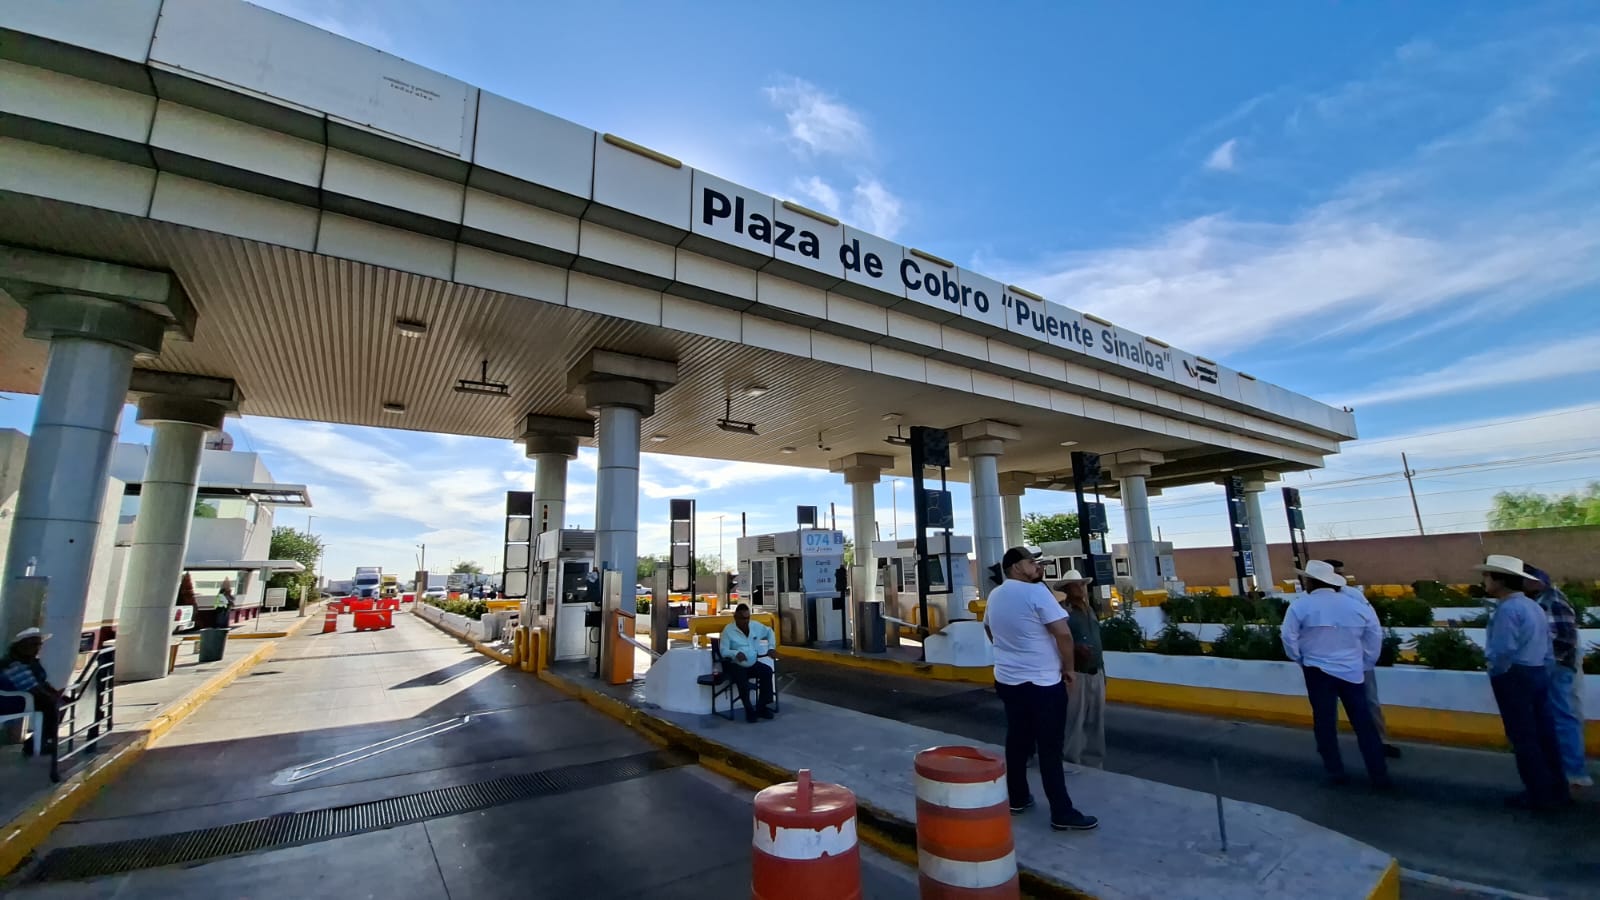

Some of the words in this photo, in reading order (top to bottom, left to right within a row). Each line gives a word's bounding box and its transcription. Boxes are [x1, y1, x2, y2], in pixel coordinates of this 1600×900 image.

[703, 187, 820, 260] Plaza
[839, 239, 884, 279] de
[899, 258, 990, 313] Cobro
[806, 533, 830, 546] 074
